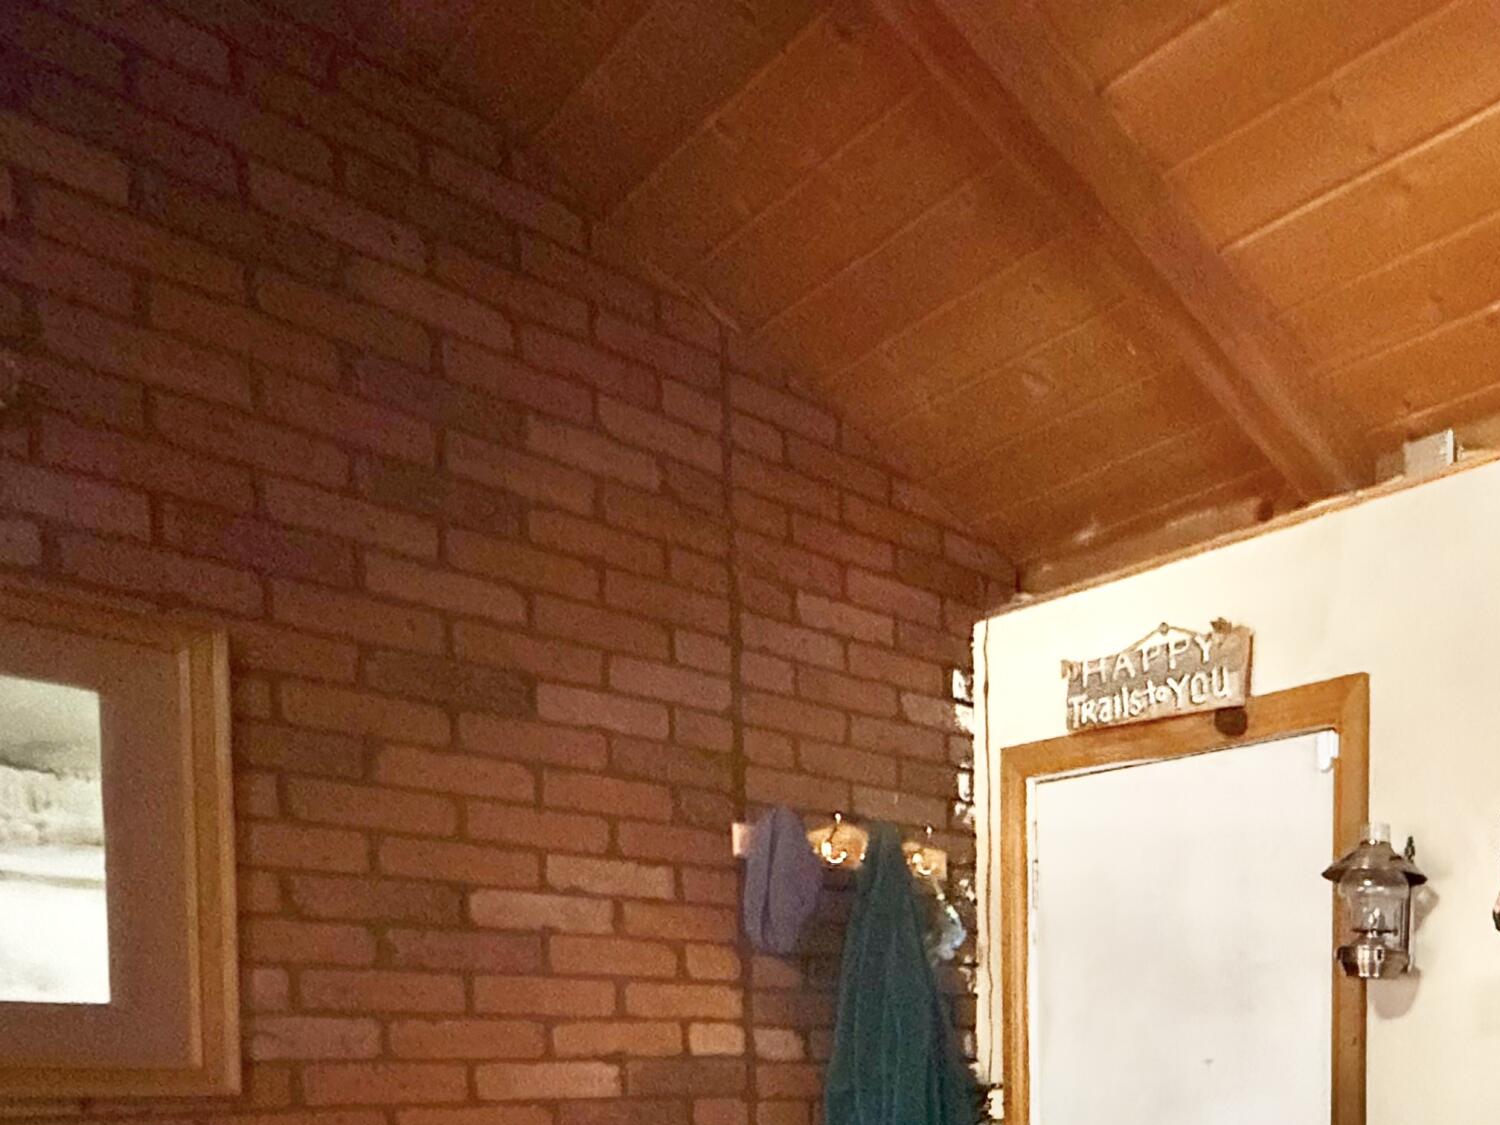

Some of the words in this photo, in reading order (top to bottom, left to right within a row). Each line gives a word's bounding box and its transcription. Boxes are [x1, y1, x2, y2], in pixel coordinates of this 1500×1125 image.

[1081, 634, 1214, 688] HAPPY
[1146, 678, 1170, 706] to
[1166, 665, 1234, 710] YOU
